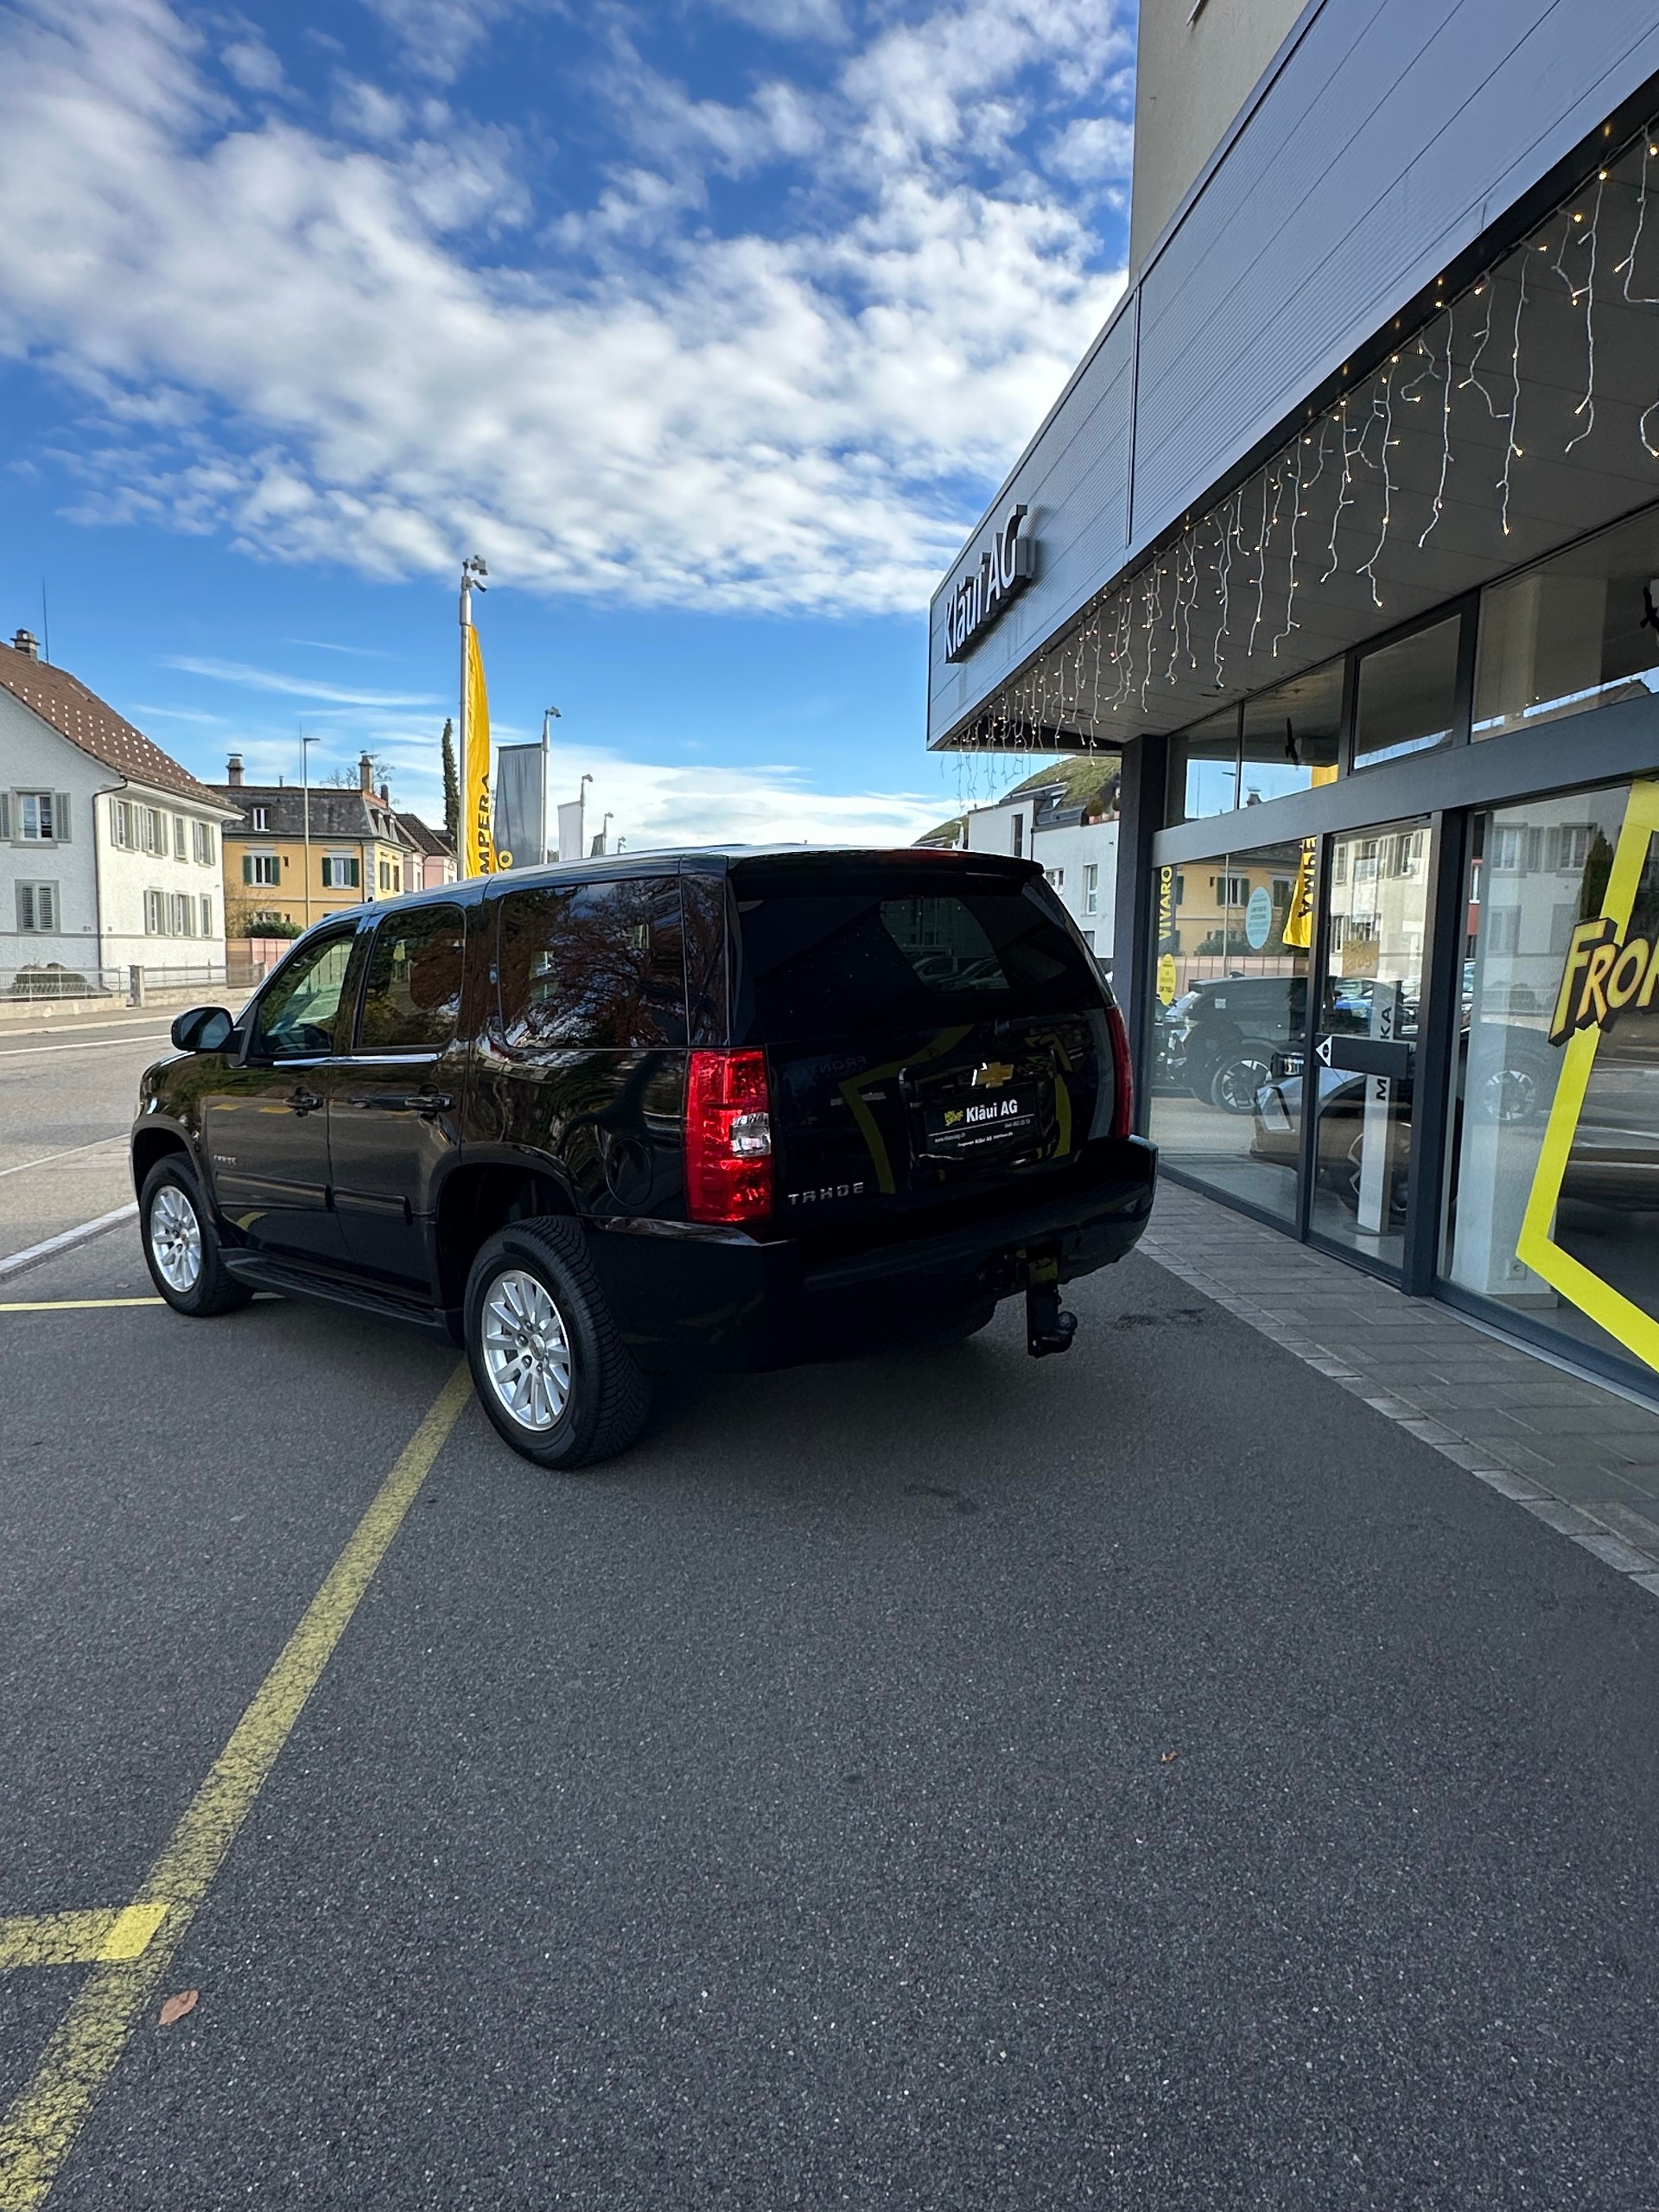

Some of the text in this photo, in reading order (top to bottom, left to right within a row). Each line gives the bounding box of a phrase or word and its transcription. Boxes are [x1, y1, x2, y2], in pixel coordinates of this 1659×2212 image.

[944, 505, 1032, 664] Kläui AG
[478, 773, 490, 875] MPERA
[1159, 866, 1173, 941] VIVARO
[966, 1103, 997, 1123] Kläui
[1001, 1099, 1018, 1116] AG
[787, 1182, 864, 1205] TAHOE
